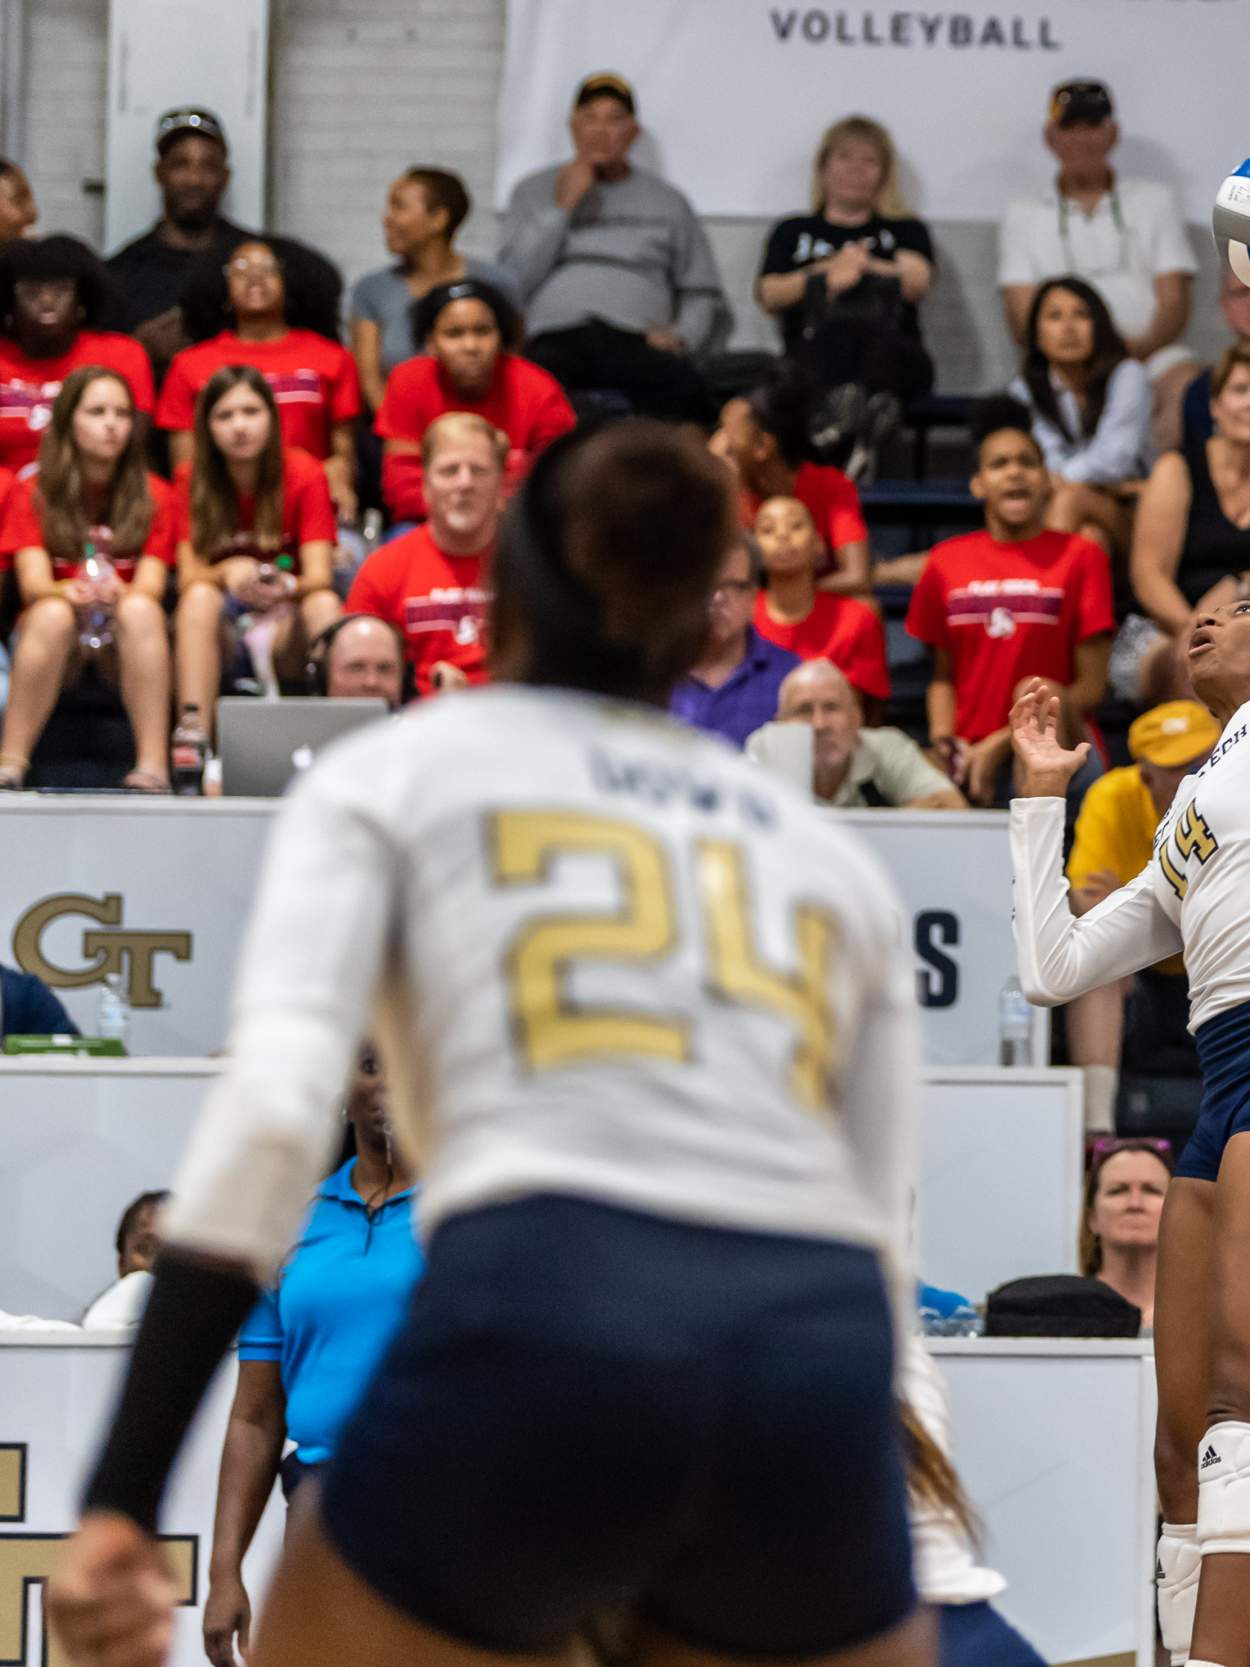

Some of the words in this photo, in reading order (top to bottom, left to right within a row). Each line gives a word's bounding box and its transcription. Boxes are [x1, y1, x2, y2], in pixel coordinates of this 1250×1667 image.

[770, 10, 1062, 51] VOLLEYBALL
[1199, 724, 1248, 778] ECH
[1159, 797, 1220, 901] 14
[488, 806, 842, 1125] 24
